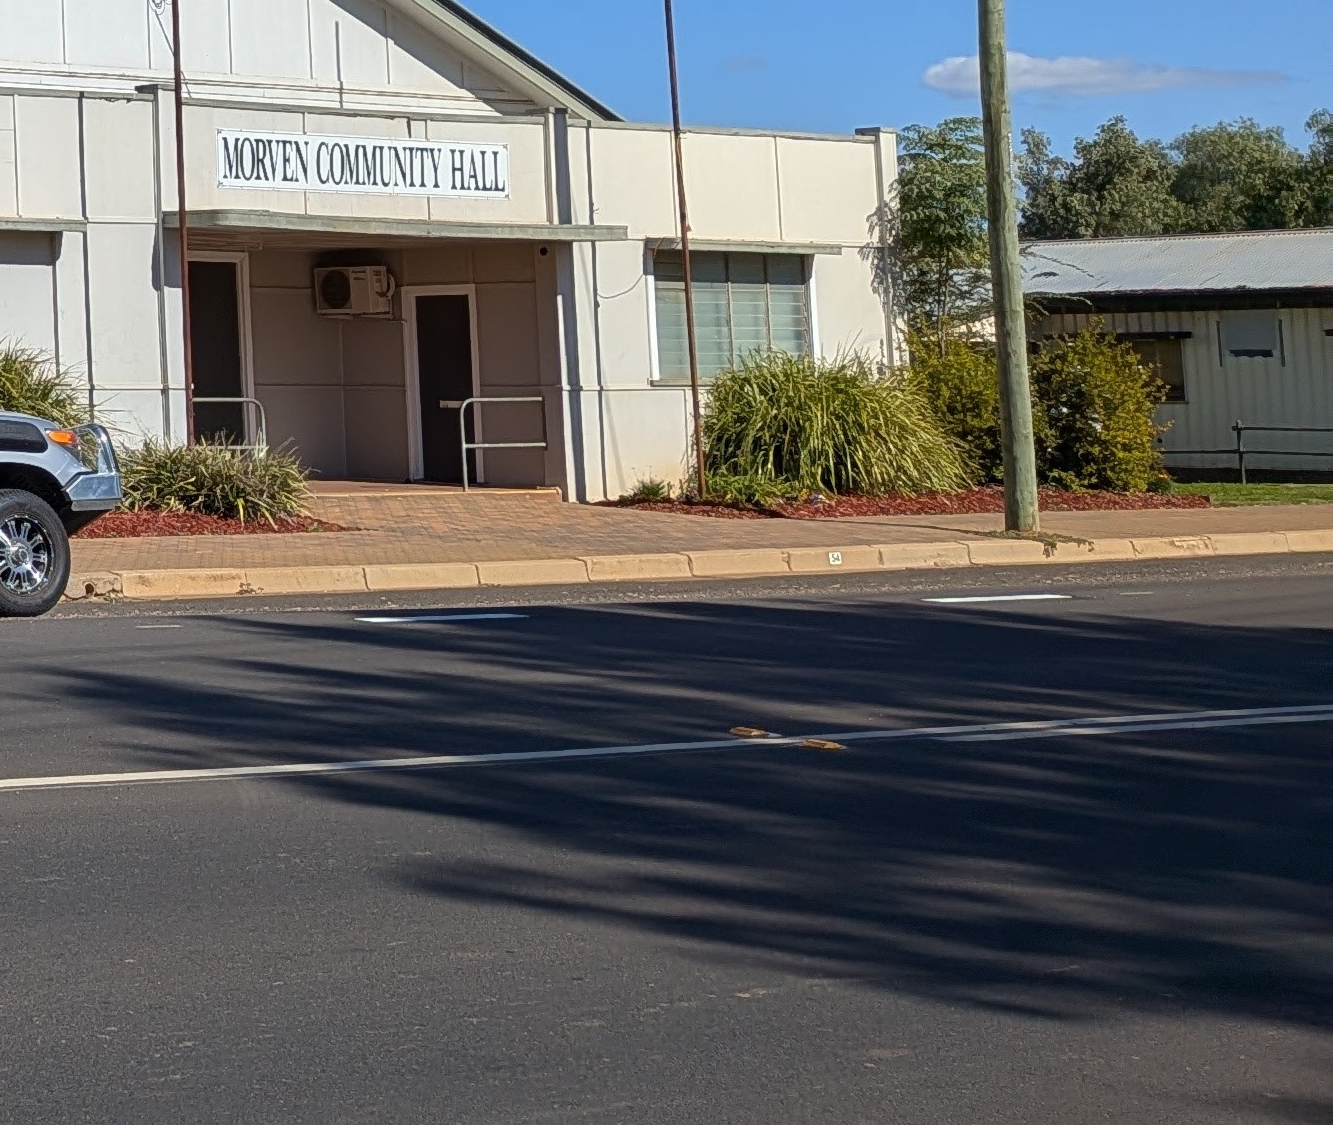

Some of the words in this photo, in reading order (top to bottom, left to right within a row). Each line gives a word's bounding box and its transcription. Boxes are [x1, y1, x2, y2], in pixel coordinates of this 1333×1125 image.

[221, 136, 310, 185] MORVEN
[316, 140, 442, 189] COMMUNITY
[449, 148, 506, 193] HALL
